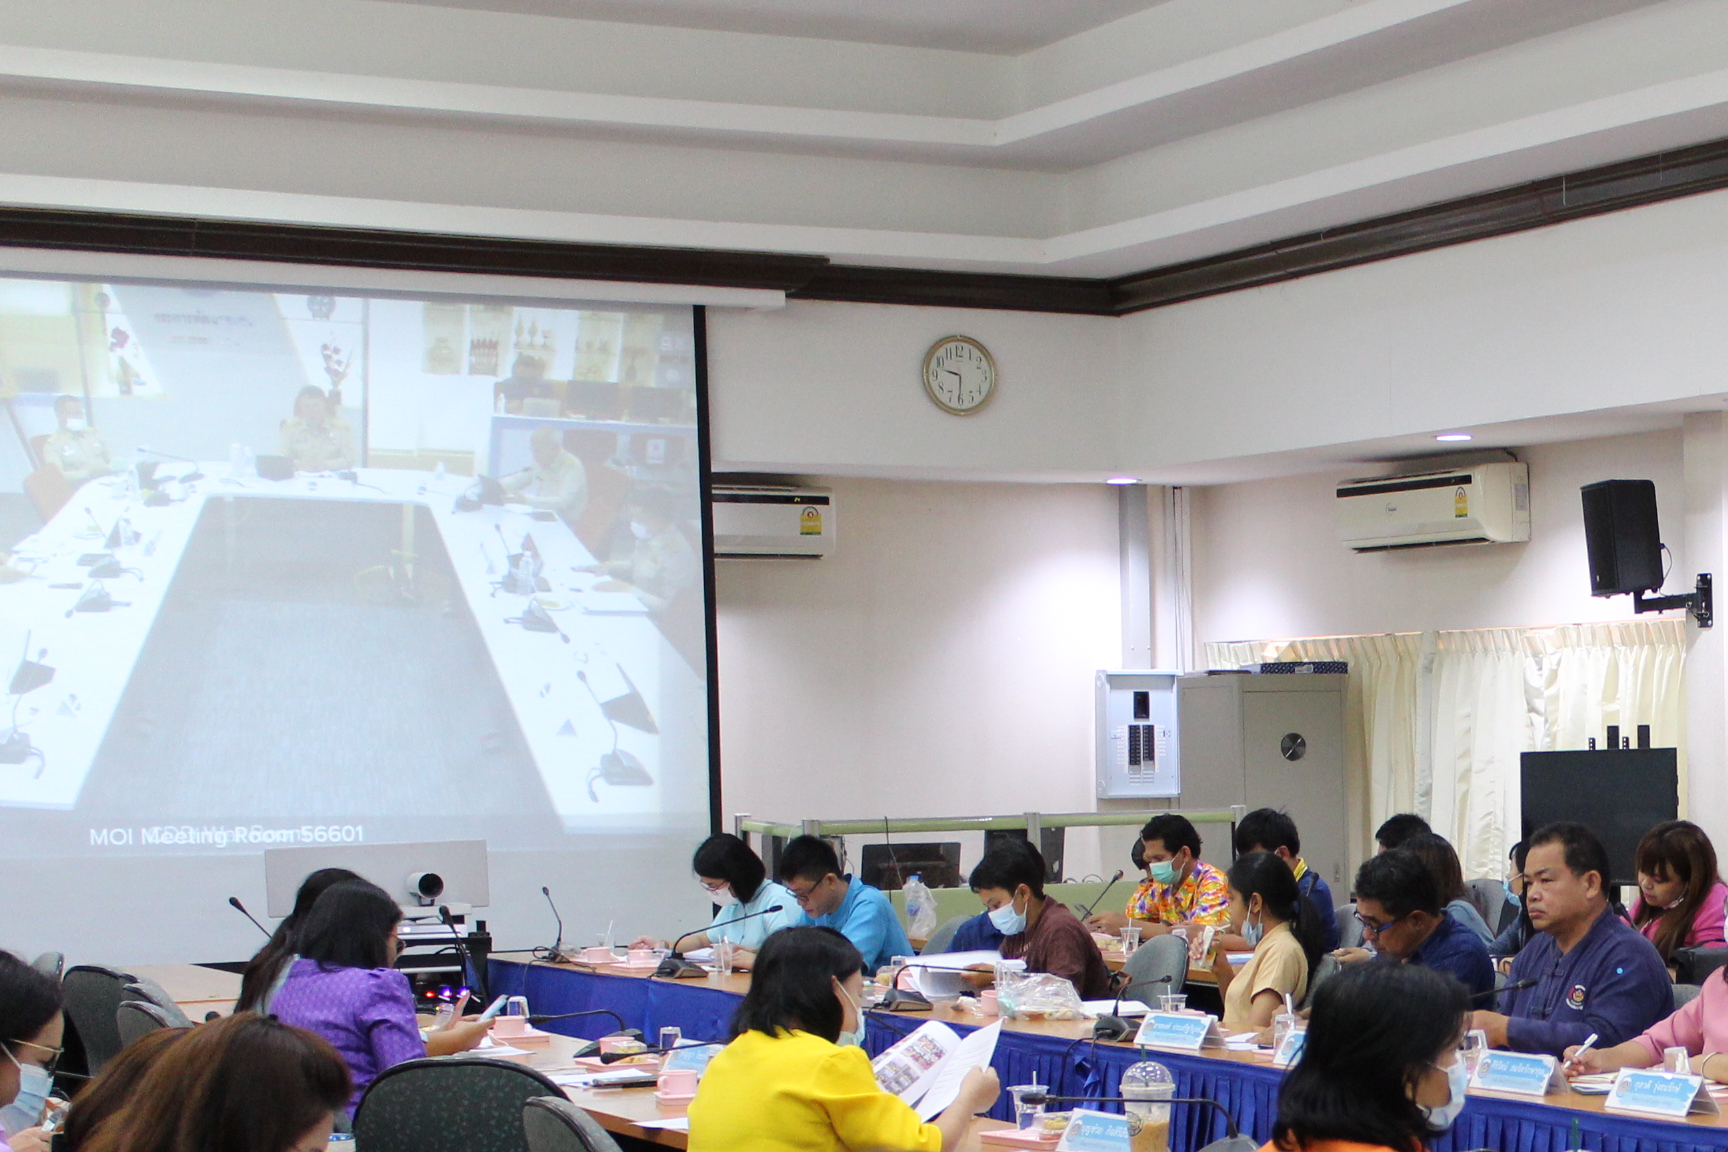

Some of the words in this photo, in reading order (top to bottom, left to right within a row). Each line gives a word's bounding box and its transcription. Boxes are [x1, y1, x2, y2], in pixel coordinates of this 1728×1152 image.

[90, 827, 133, 846] MOI
[141, 826, 228, 848] Meeting
[301, 825, 364, 843] 56601
